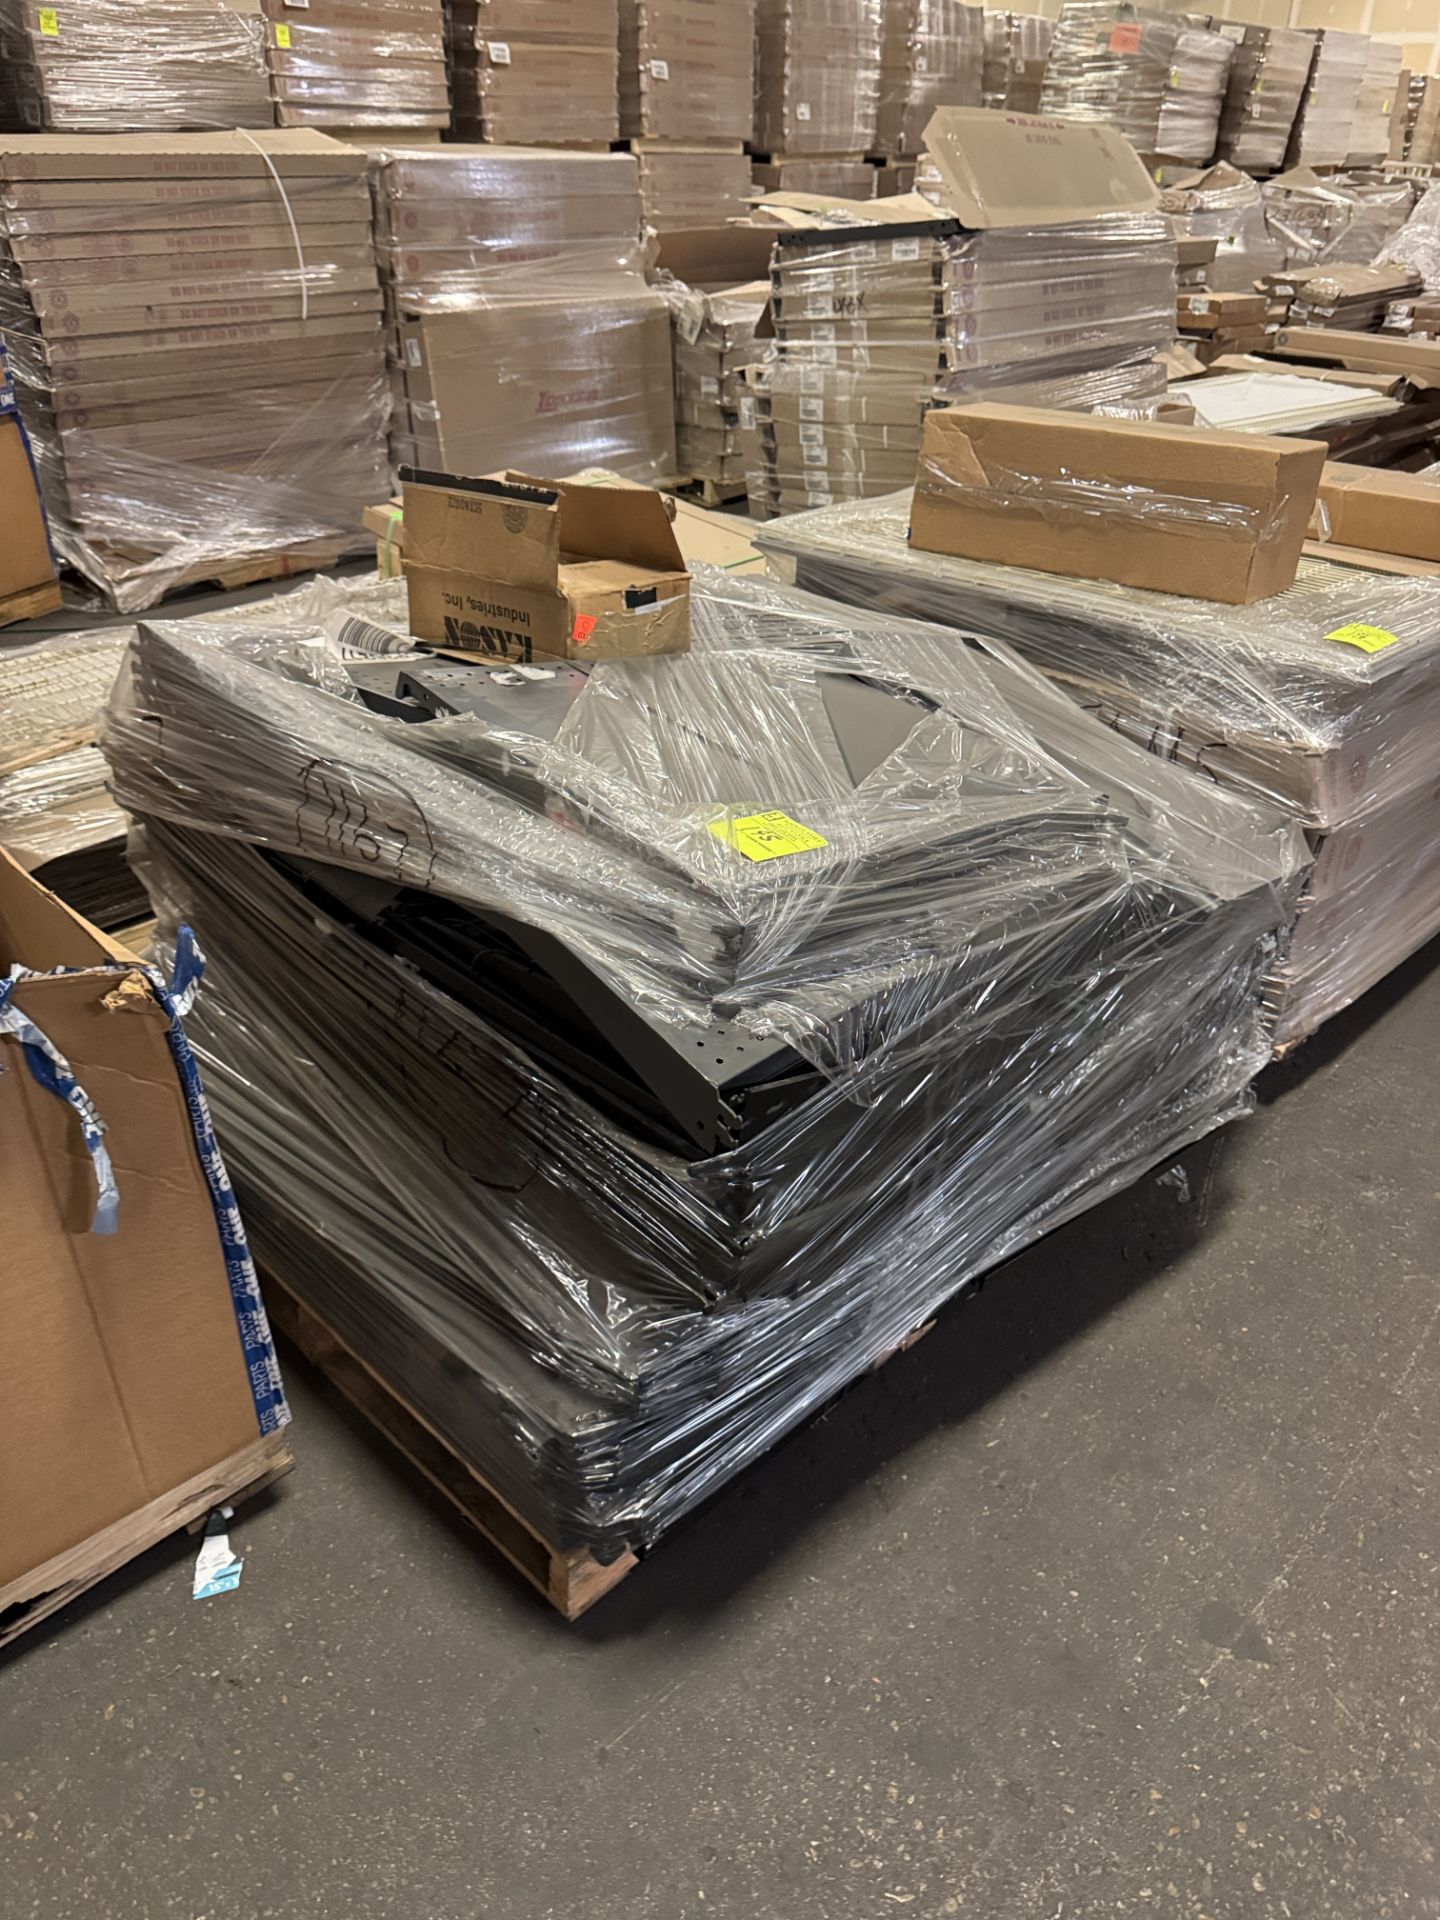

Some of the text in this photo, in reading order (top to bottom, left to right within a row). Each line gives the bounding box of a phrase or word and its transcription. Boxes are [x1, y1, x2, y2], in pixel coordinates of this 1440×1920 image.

[441, 592, 531, 627] Industries, Inc.
[249, 1360, 271, 1400] PARTS
